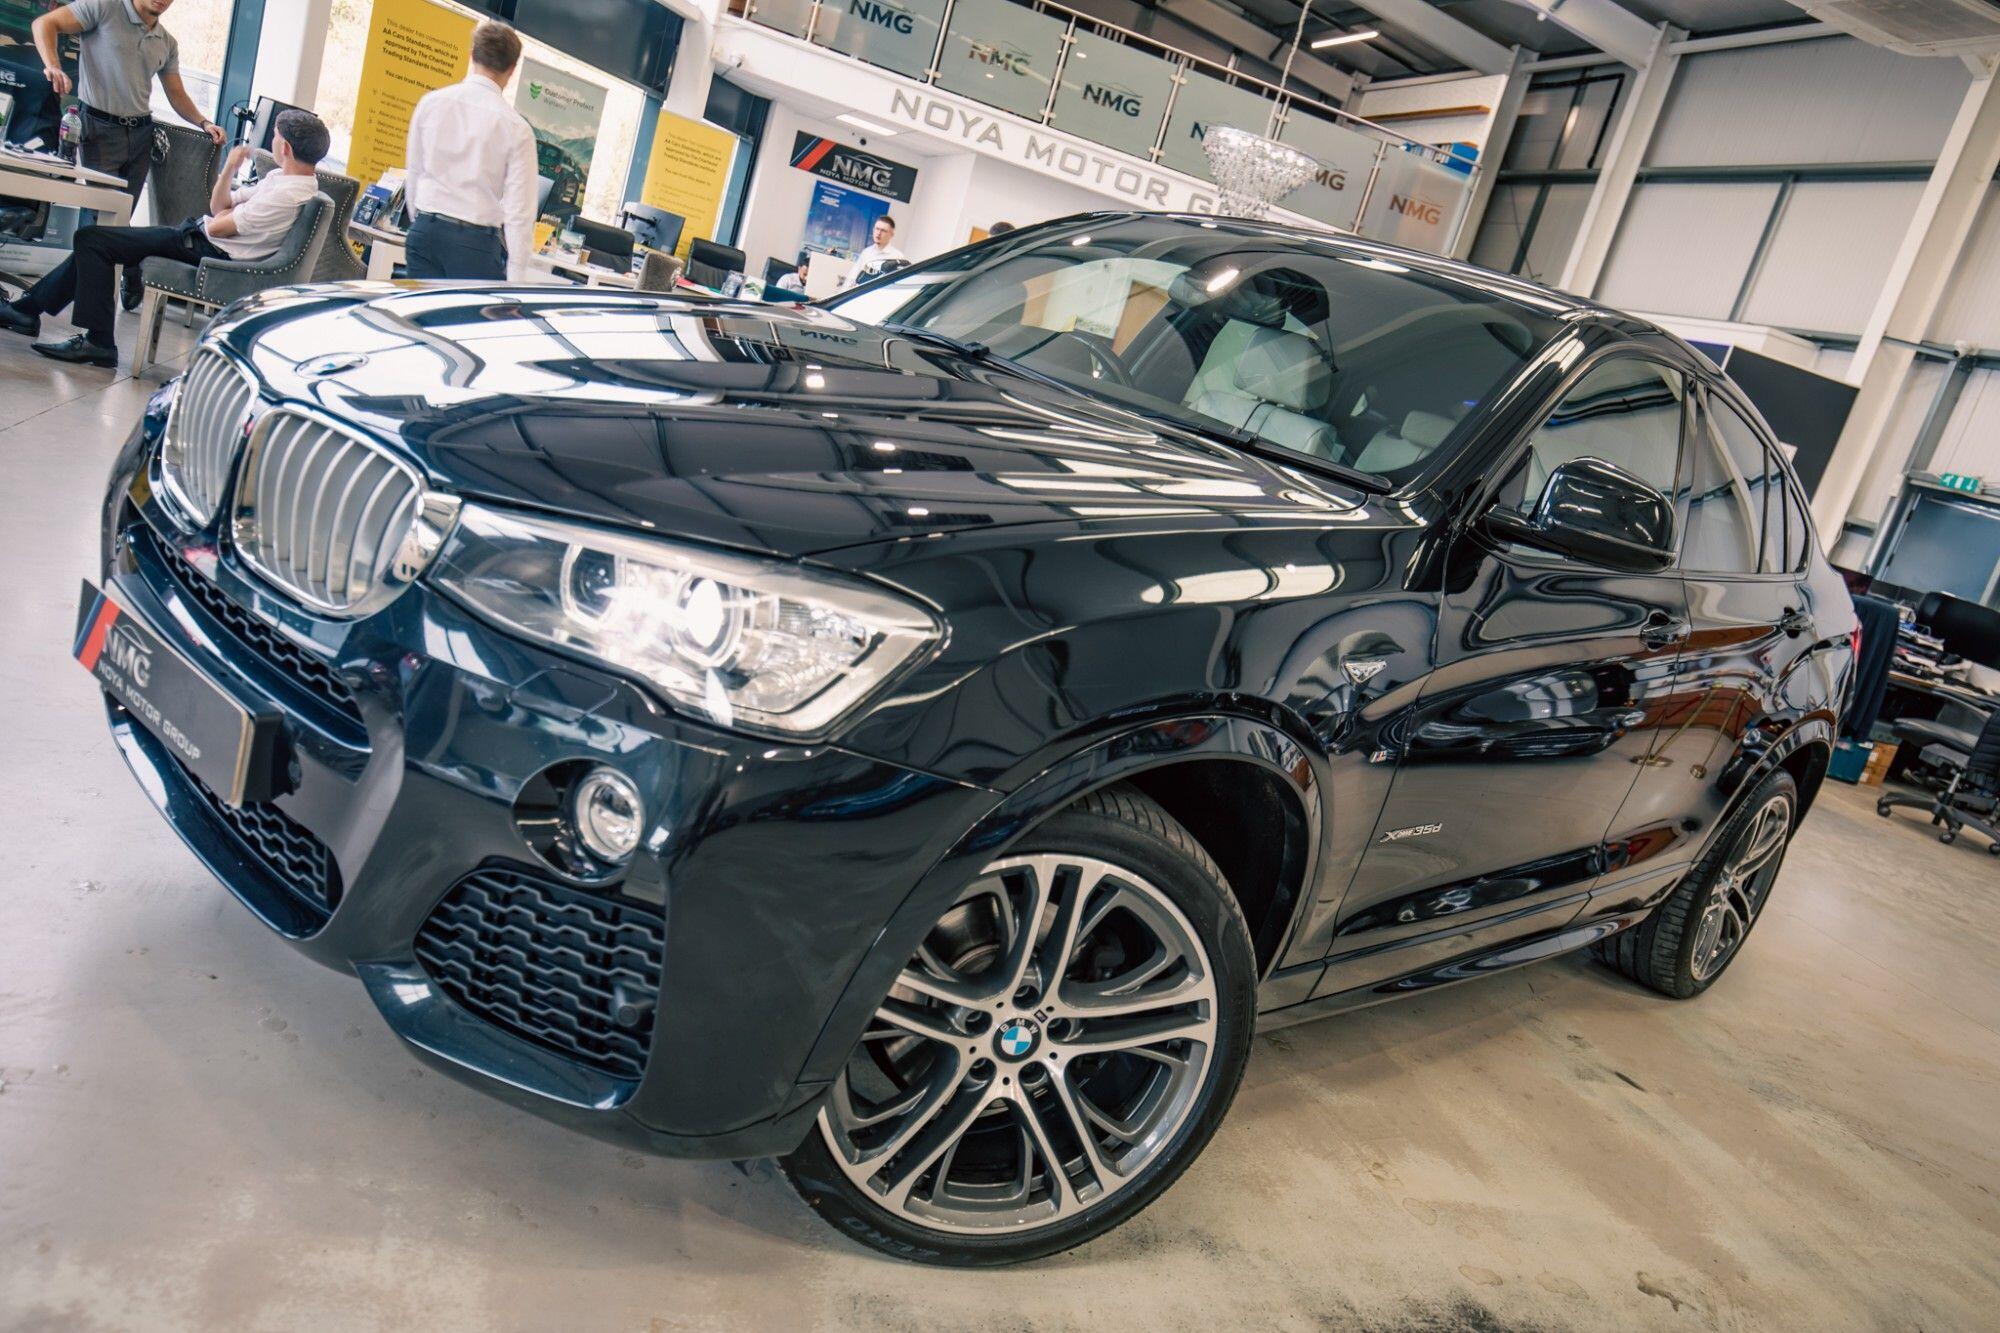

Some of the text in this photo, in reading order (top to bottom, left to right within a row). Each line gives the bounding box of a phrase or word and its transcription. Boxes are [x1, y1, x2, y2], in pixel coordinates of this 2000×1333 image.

[848, 0, 914, 35] NMG
[383, 27, 392, 35] AA
[392, 31, 405, 41] Cars
[434, 46, 450, 57] which
[383, 47, 403, 61] Trading
[403, 55, 430, 70] Standards
[385, 40, 410, 53] approved
[410, 46, 418, 56] by
[418, 50, 428, 59] The
[968, 43, 1032, 76] NMG
[1082, 83, 1141, 117] NMG
[890, 88, 1171, 206] NOYA MOTOR
[820, 168, 898, 196] NOYA MOTOR GROUP
[831, 154, 892, 188] NMG
[1389, 194, 1441, 225] NMG
[102, 624, 151, 688] NMG
[99, 659, 201, 759] NOYA MOTOR GROUP
[1000, 1018, 1039, 1034] BMW
